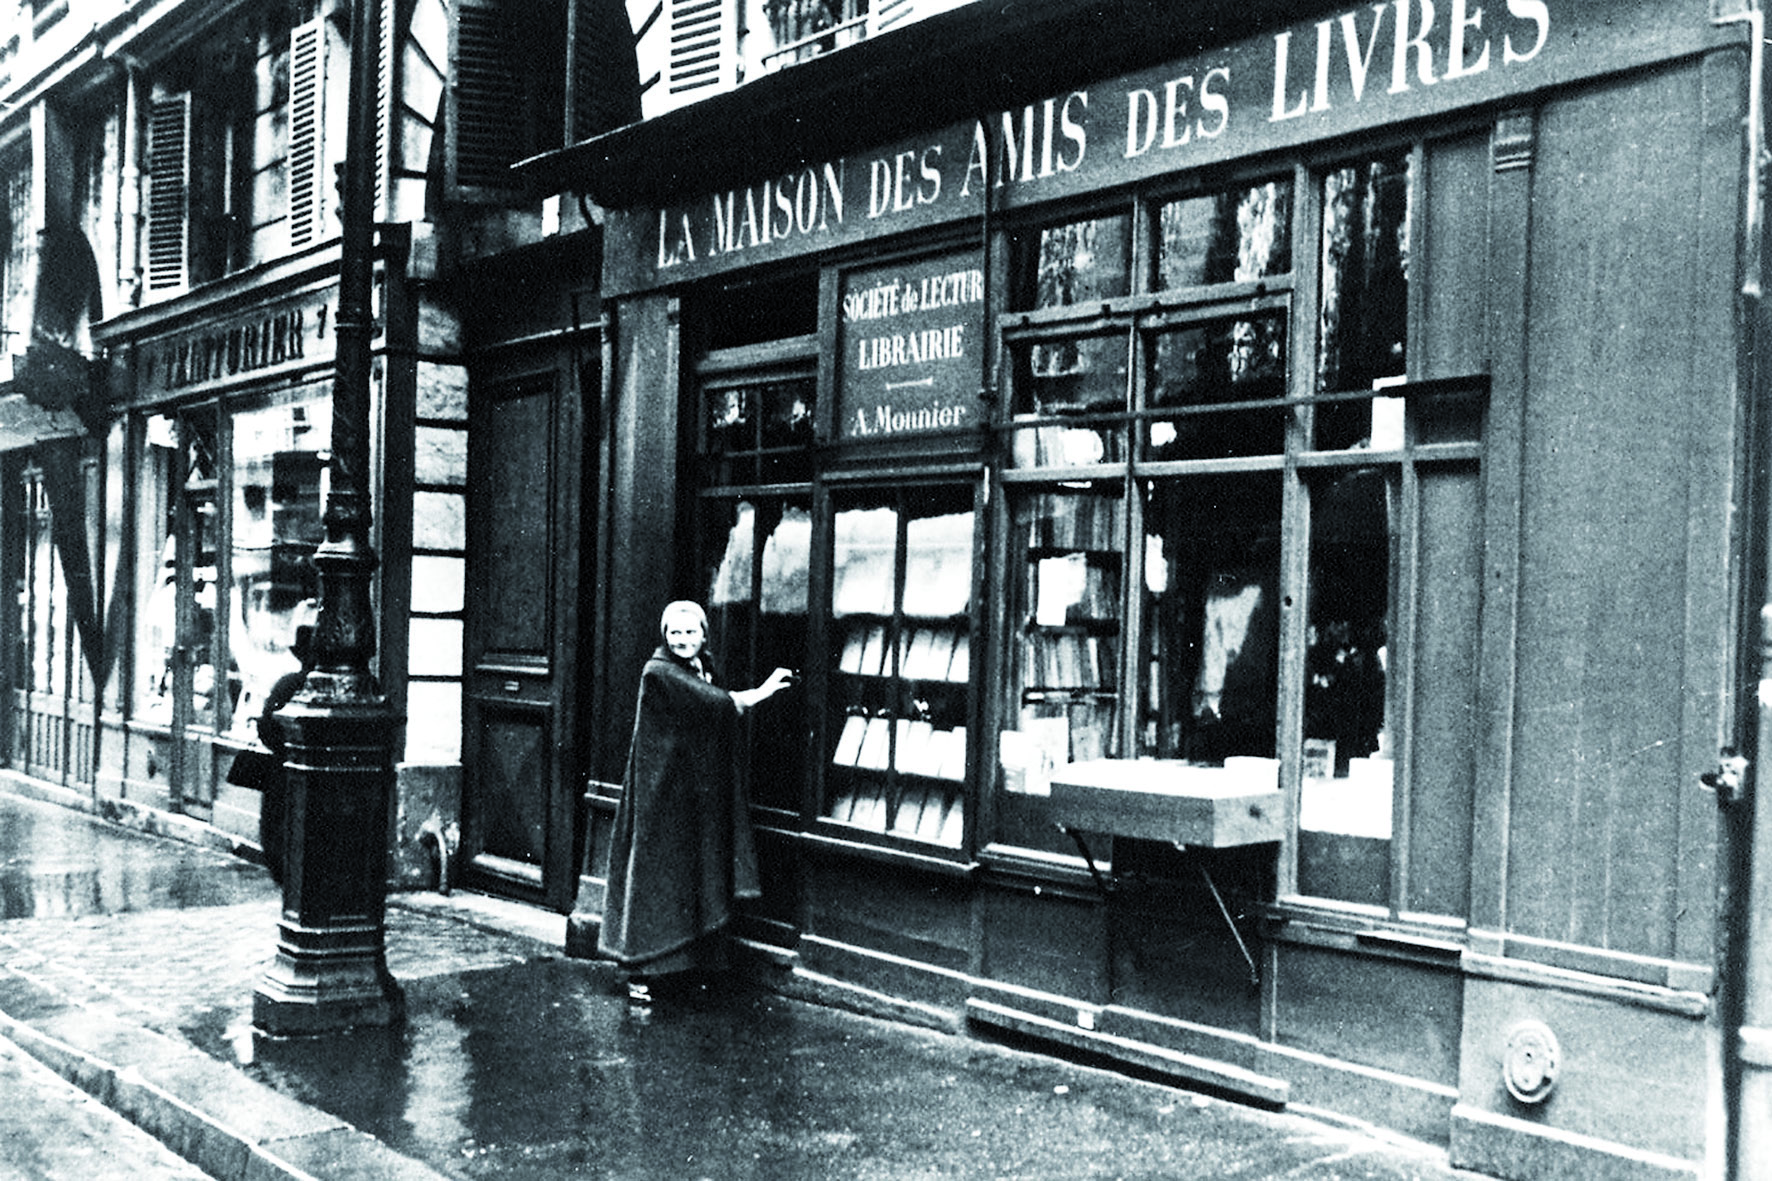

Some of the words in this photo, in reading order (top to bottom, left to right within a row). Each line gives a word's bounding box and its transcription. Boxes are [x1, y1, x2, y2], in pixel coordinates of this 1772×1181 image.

[656, 209, 696, 269] LA
[708, 158, 845, 257] MAISON
[867, 145, 943, 219] DES
[959, 91, 1089, 197] AMIS
[1123, 67, 1231, 159] DES
[1268, 0, 1550, 123] LIVRES
[901, 283, 918, 313] de
[920, 269, 985, 310] LECTUR
[858, 325, 964, 370] LIBRAIRIE
